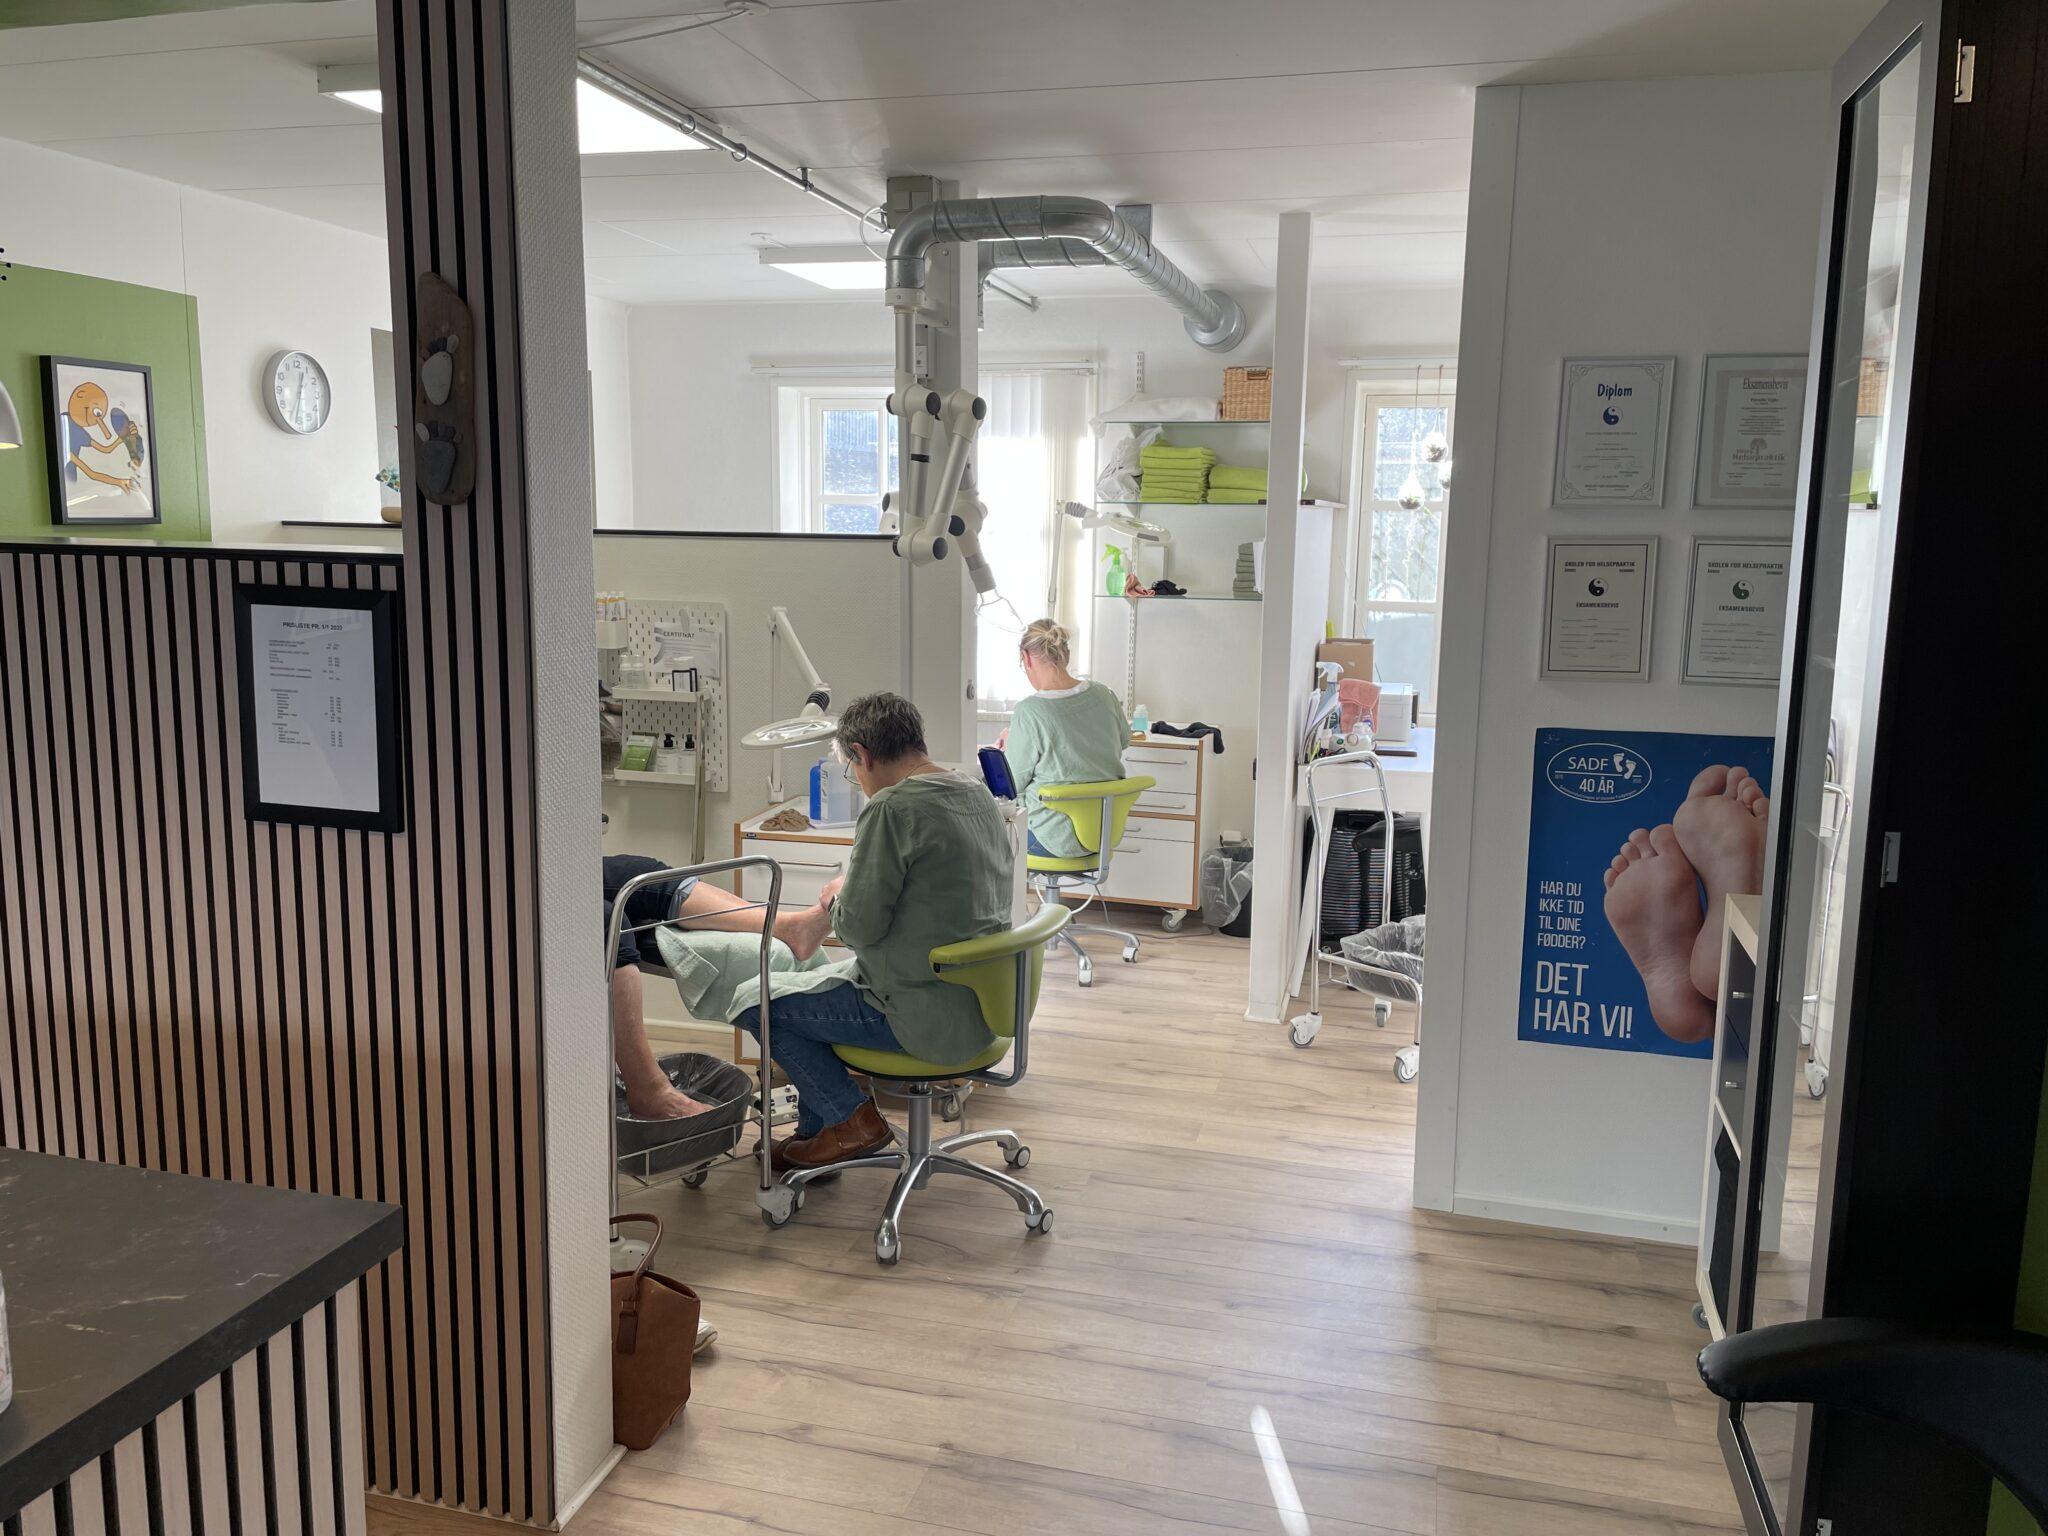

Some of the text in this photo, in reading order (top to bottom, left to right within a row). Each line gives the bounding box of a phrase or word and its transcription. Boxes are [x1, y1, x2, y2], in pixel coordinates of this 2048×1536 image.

[293, 360, 301, 369] 12
[305, 366, 308, 374] 1
[311, 377, 317, 386] 2
[276, 386, 282, 395] 9
[1597, 383, 1633, 400] Diplom
[280, 400, 286, 409] 8
[1568, 756, 1608, 771] SADF
[1579, 778, 1595, 793] 40
[1597, 776, 1615, 794] ÅR
[1540, 880, 1582, 897] HAR DU
[1539, 898, 1585, 914] IKKE TID
[1538, 915, 1582, 932] TIL DINE
[1537, 932, 1587, 950] FØDDER?
[1535, 960, 1590, 996] DET
[1533, 998, 1633, 1039] HAR VI!
